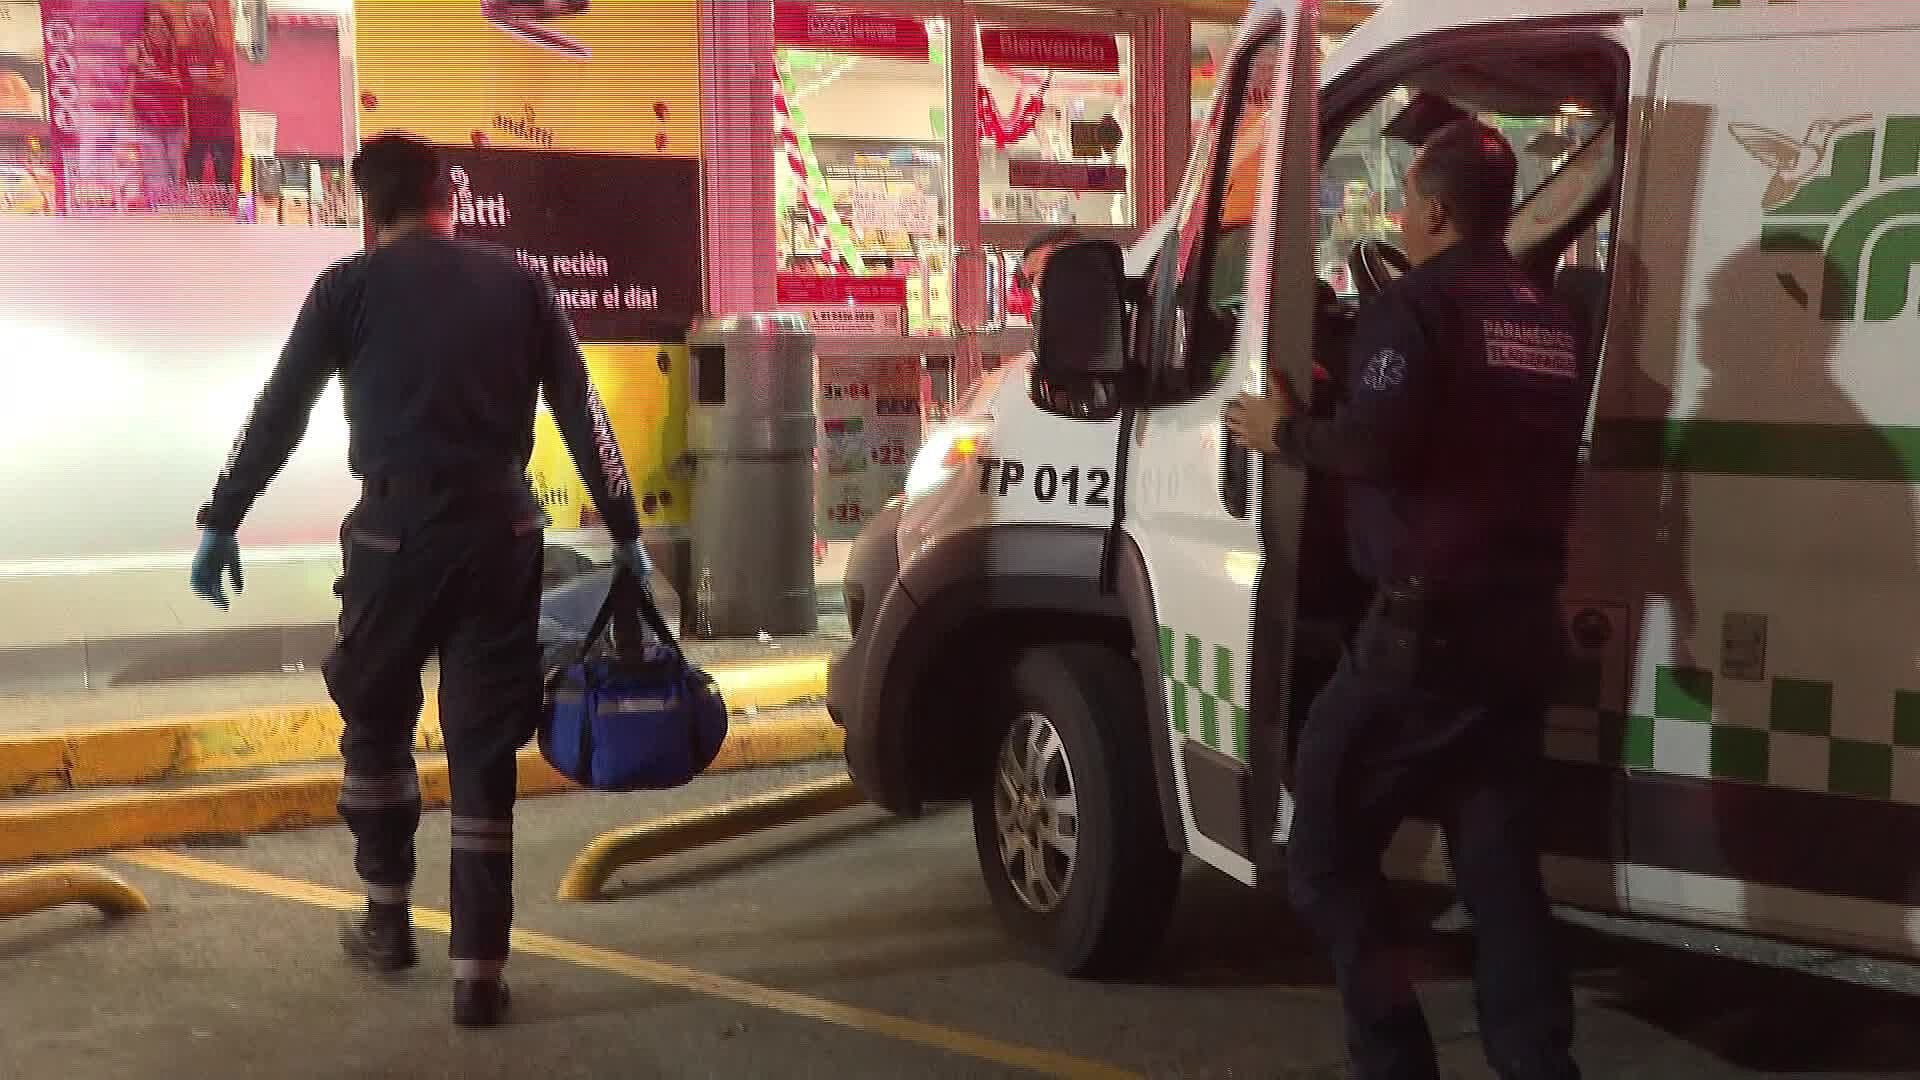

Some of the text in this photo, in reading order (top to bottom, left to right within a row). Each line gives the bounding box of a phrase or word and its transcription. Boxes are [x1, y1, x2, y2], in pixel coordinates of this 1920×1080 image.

[999, 32, 1105, 62] Bienvenido
[552, 249, 609, 277] recién
[602, 283, 620, 311] el
[977, 456, 1111, 509] TP 012
